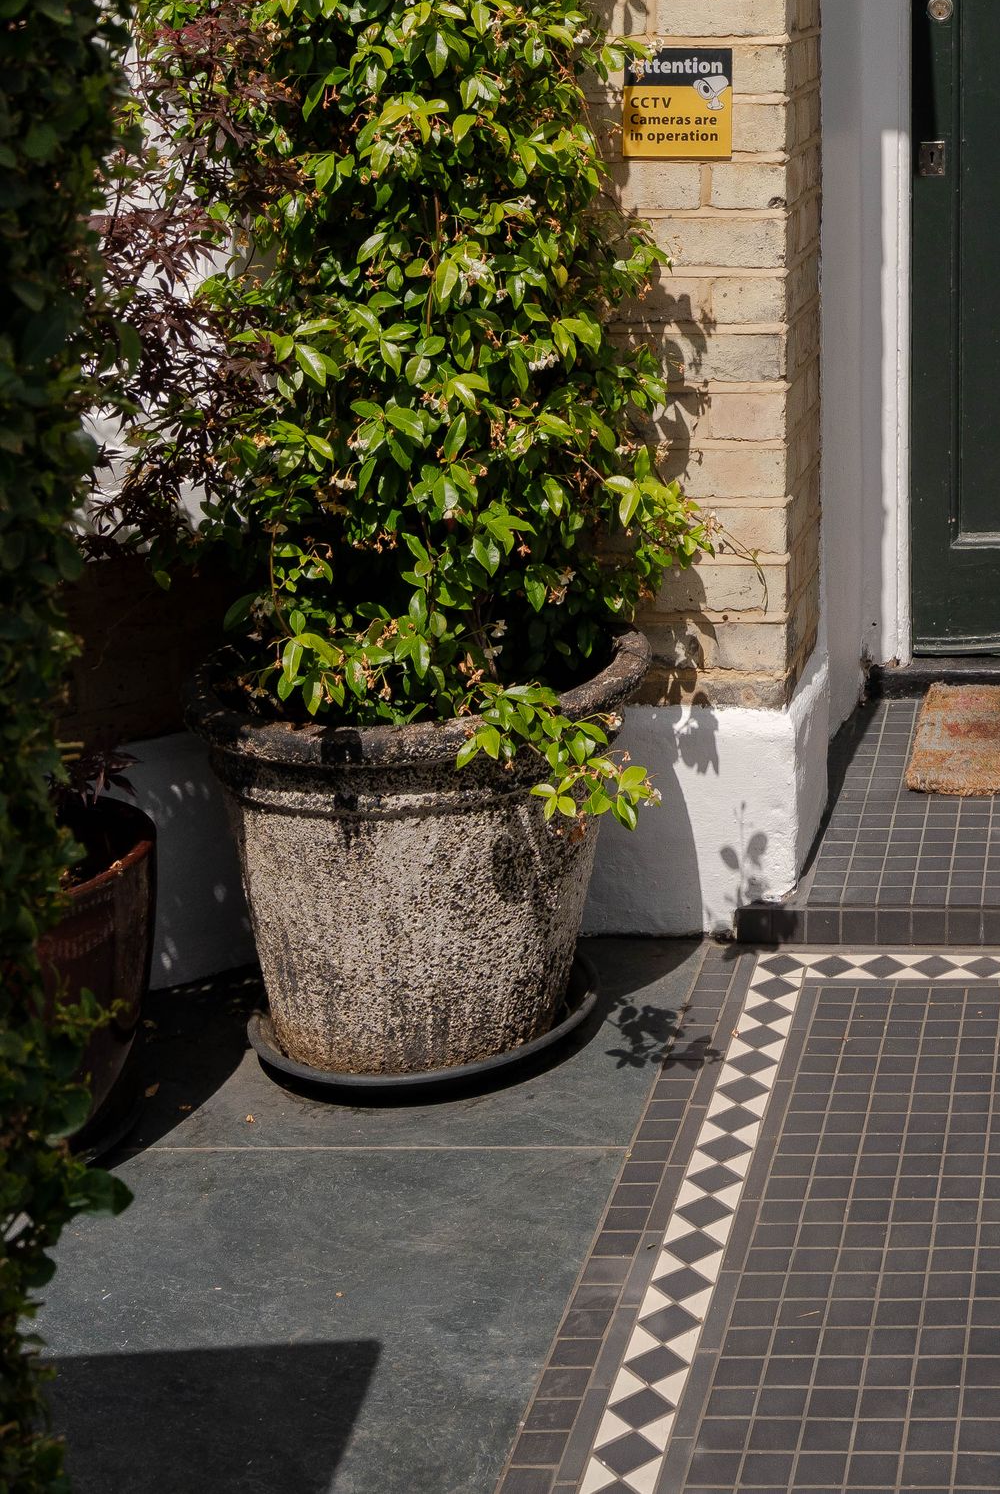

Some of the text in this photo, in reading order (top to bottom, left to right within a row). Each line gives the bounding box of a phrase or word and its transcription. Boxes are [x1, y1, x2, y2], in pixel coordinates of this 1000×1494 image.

[630, 97, 672, 109] CCTV
[630, 113, 717, 125] Cameras are
[630, 130, 719, 144] in operation
